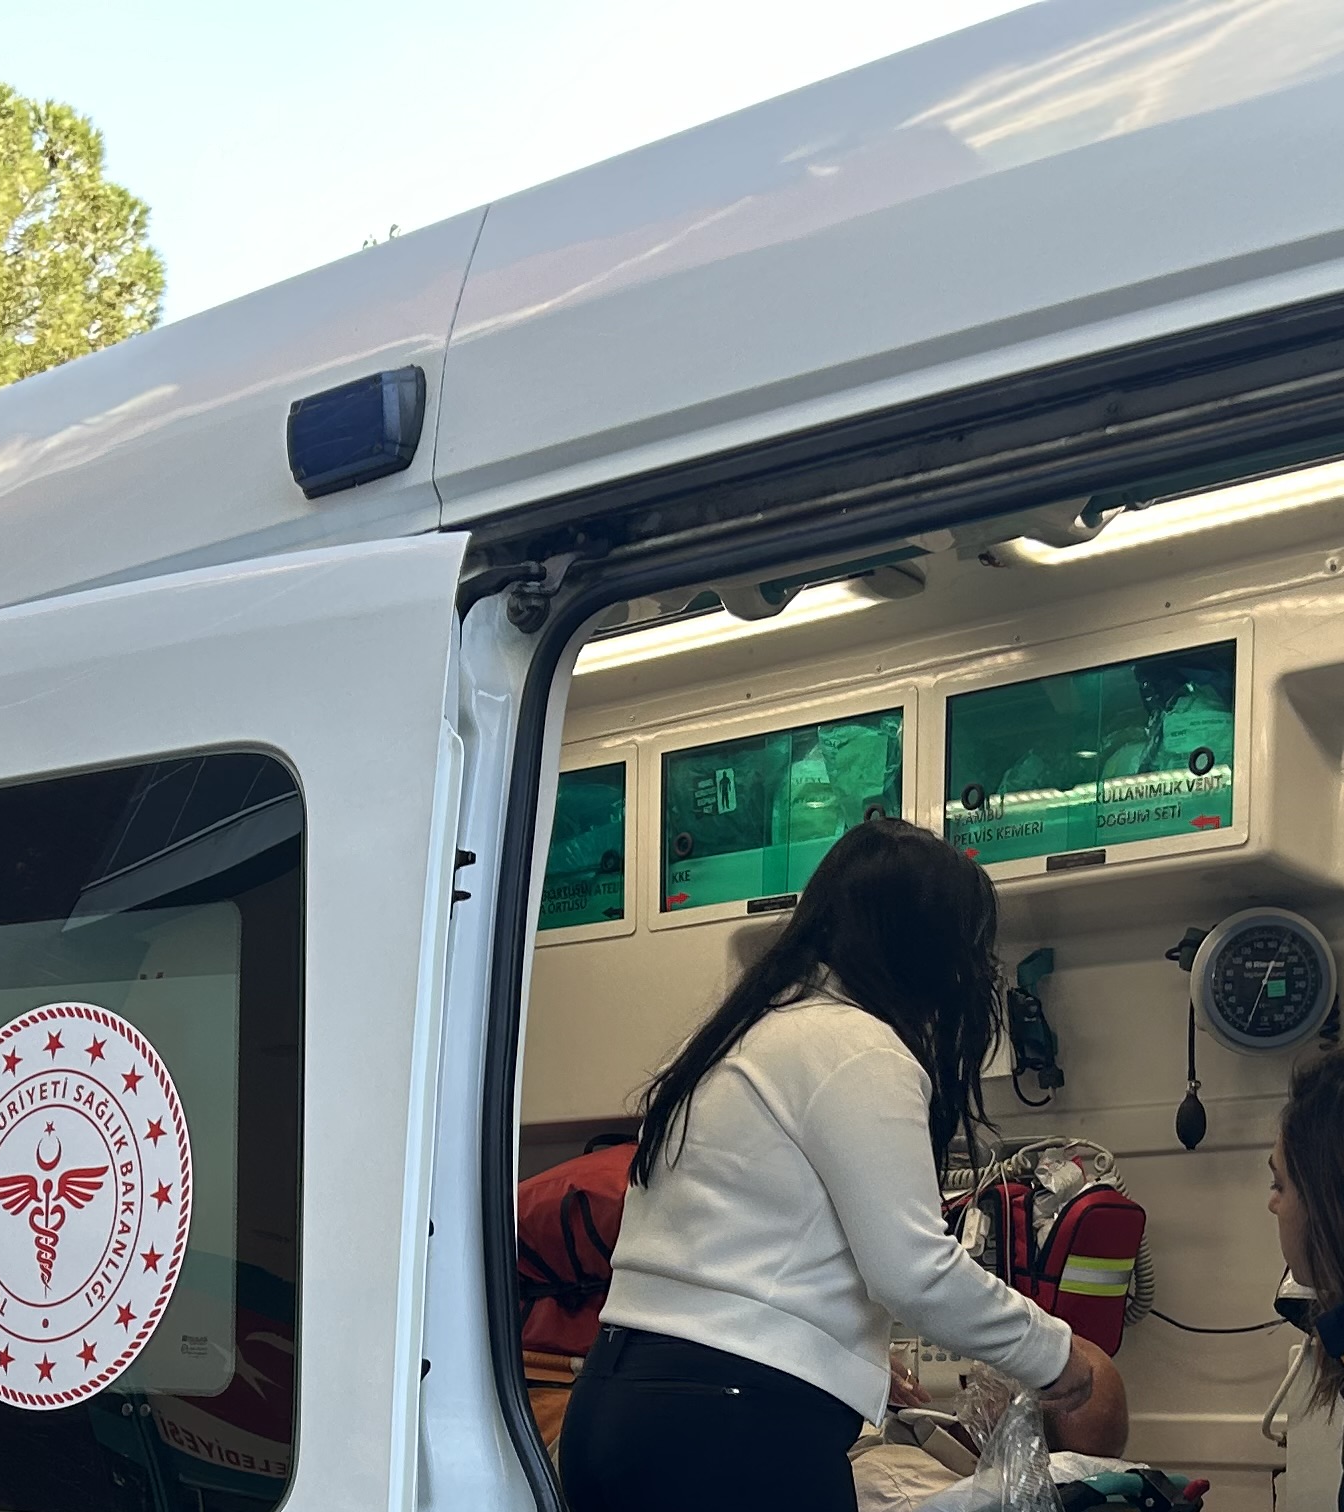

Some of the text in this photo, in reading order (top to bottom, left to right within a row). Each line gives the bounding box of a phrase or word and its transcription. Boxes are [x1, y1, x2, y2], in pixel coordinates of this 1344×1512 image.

[1097, 808, 1150, 828] DOĞUM
[672, 870, 691, 884] KKE
[73, 1084, 132, 1153] SAĞLIK
[86, 1161, 136, 1310] BAKANLIĞI
